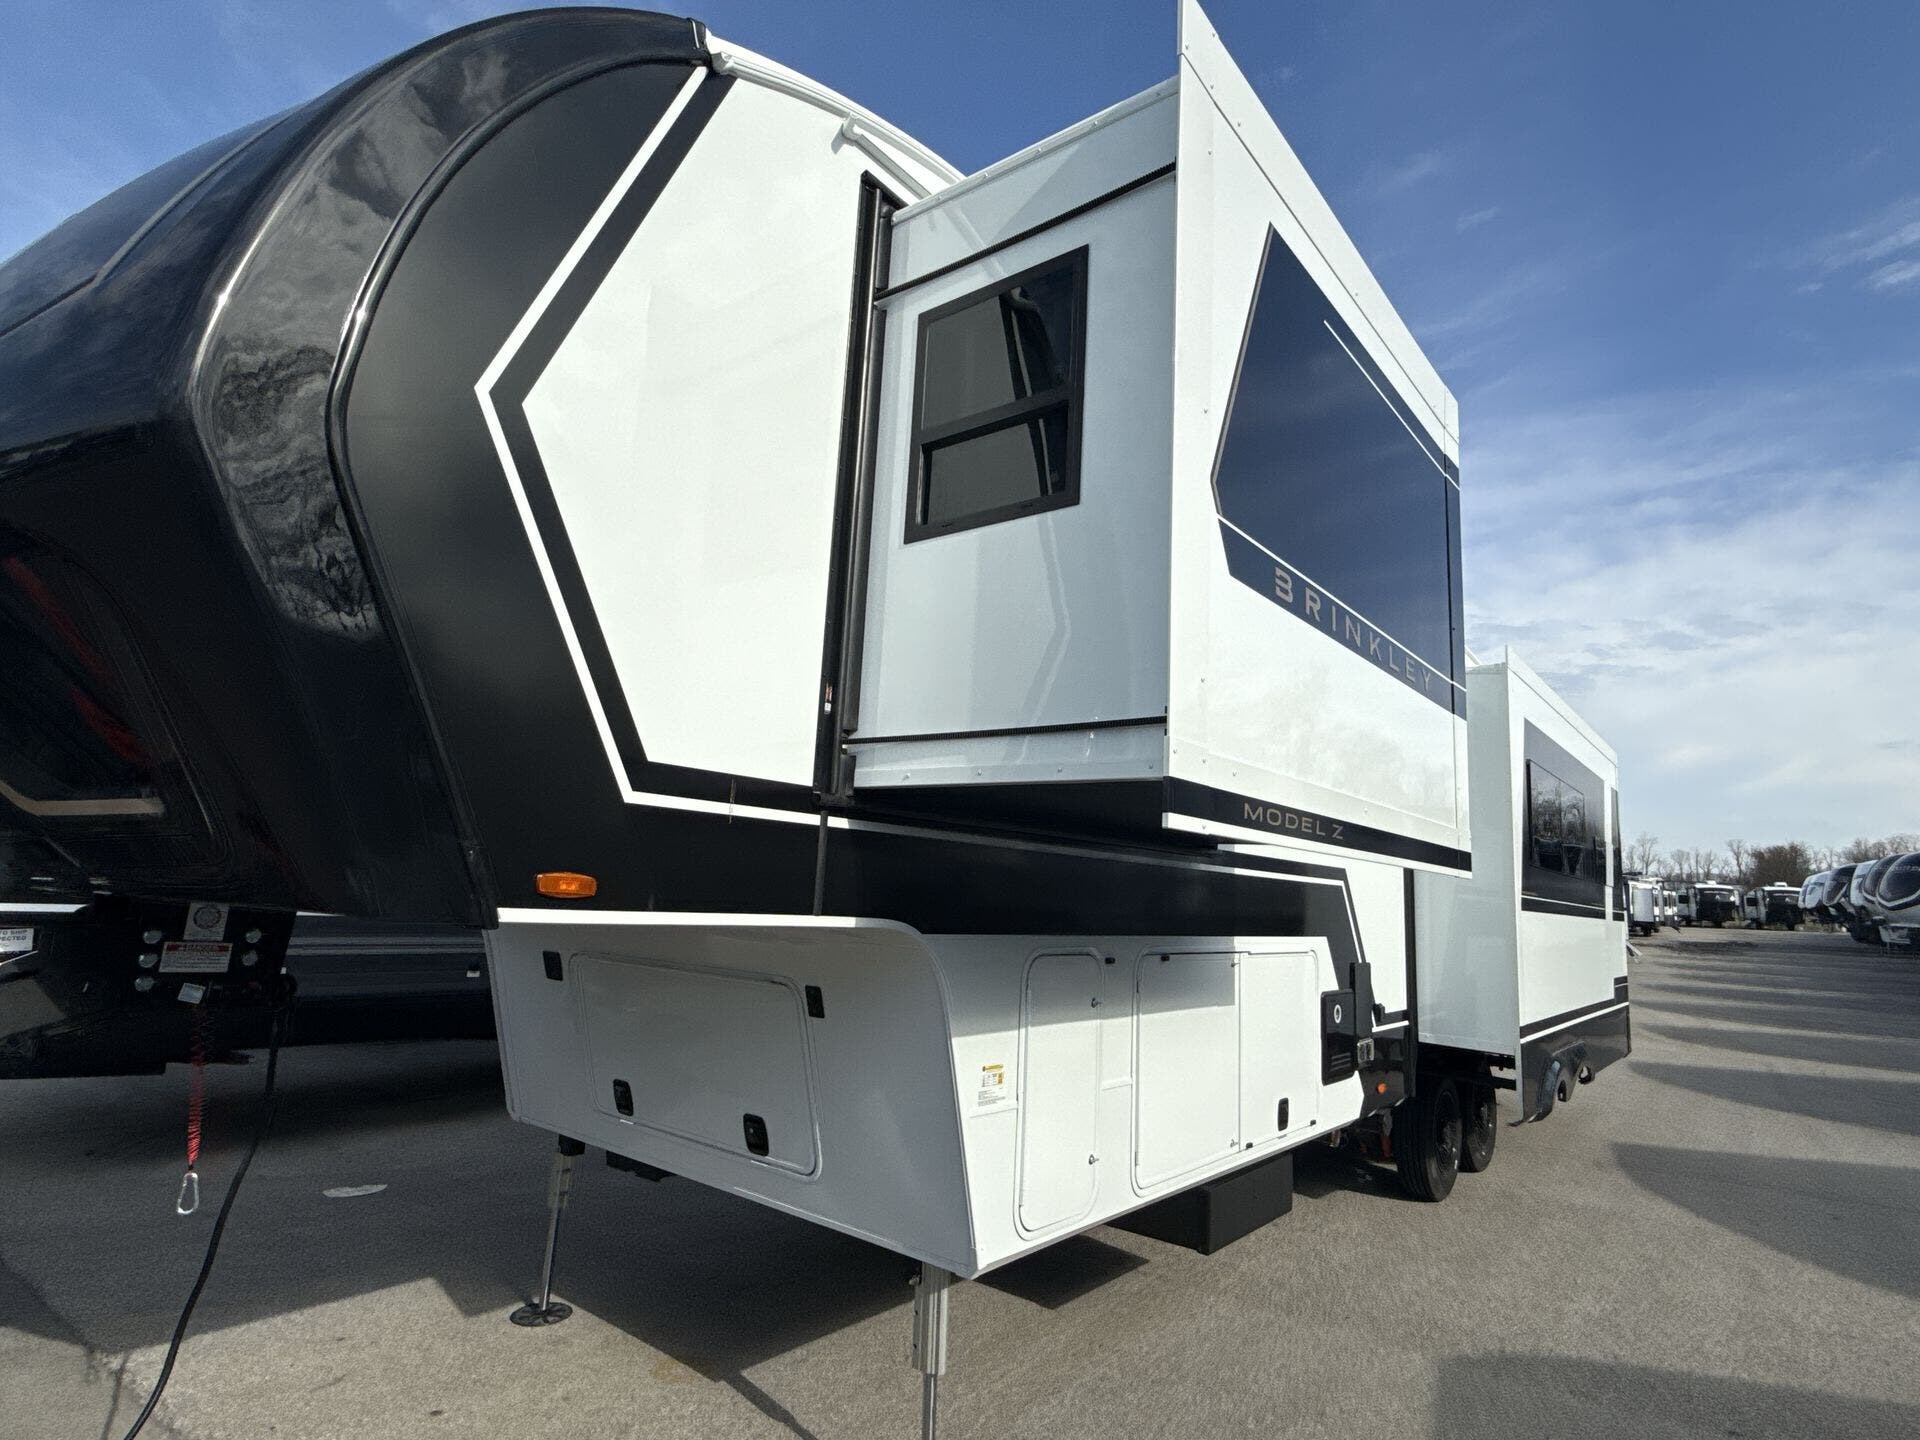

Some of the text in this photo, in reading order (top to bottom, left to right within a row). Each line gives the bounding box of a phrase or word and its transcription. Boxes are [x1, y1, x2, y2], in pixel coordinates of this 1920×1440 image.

[1274, 566, 1432, 691] BRINKLEY
[1243, 802, 1344, 840] MODEL Z
